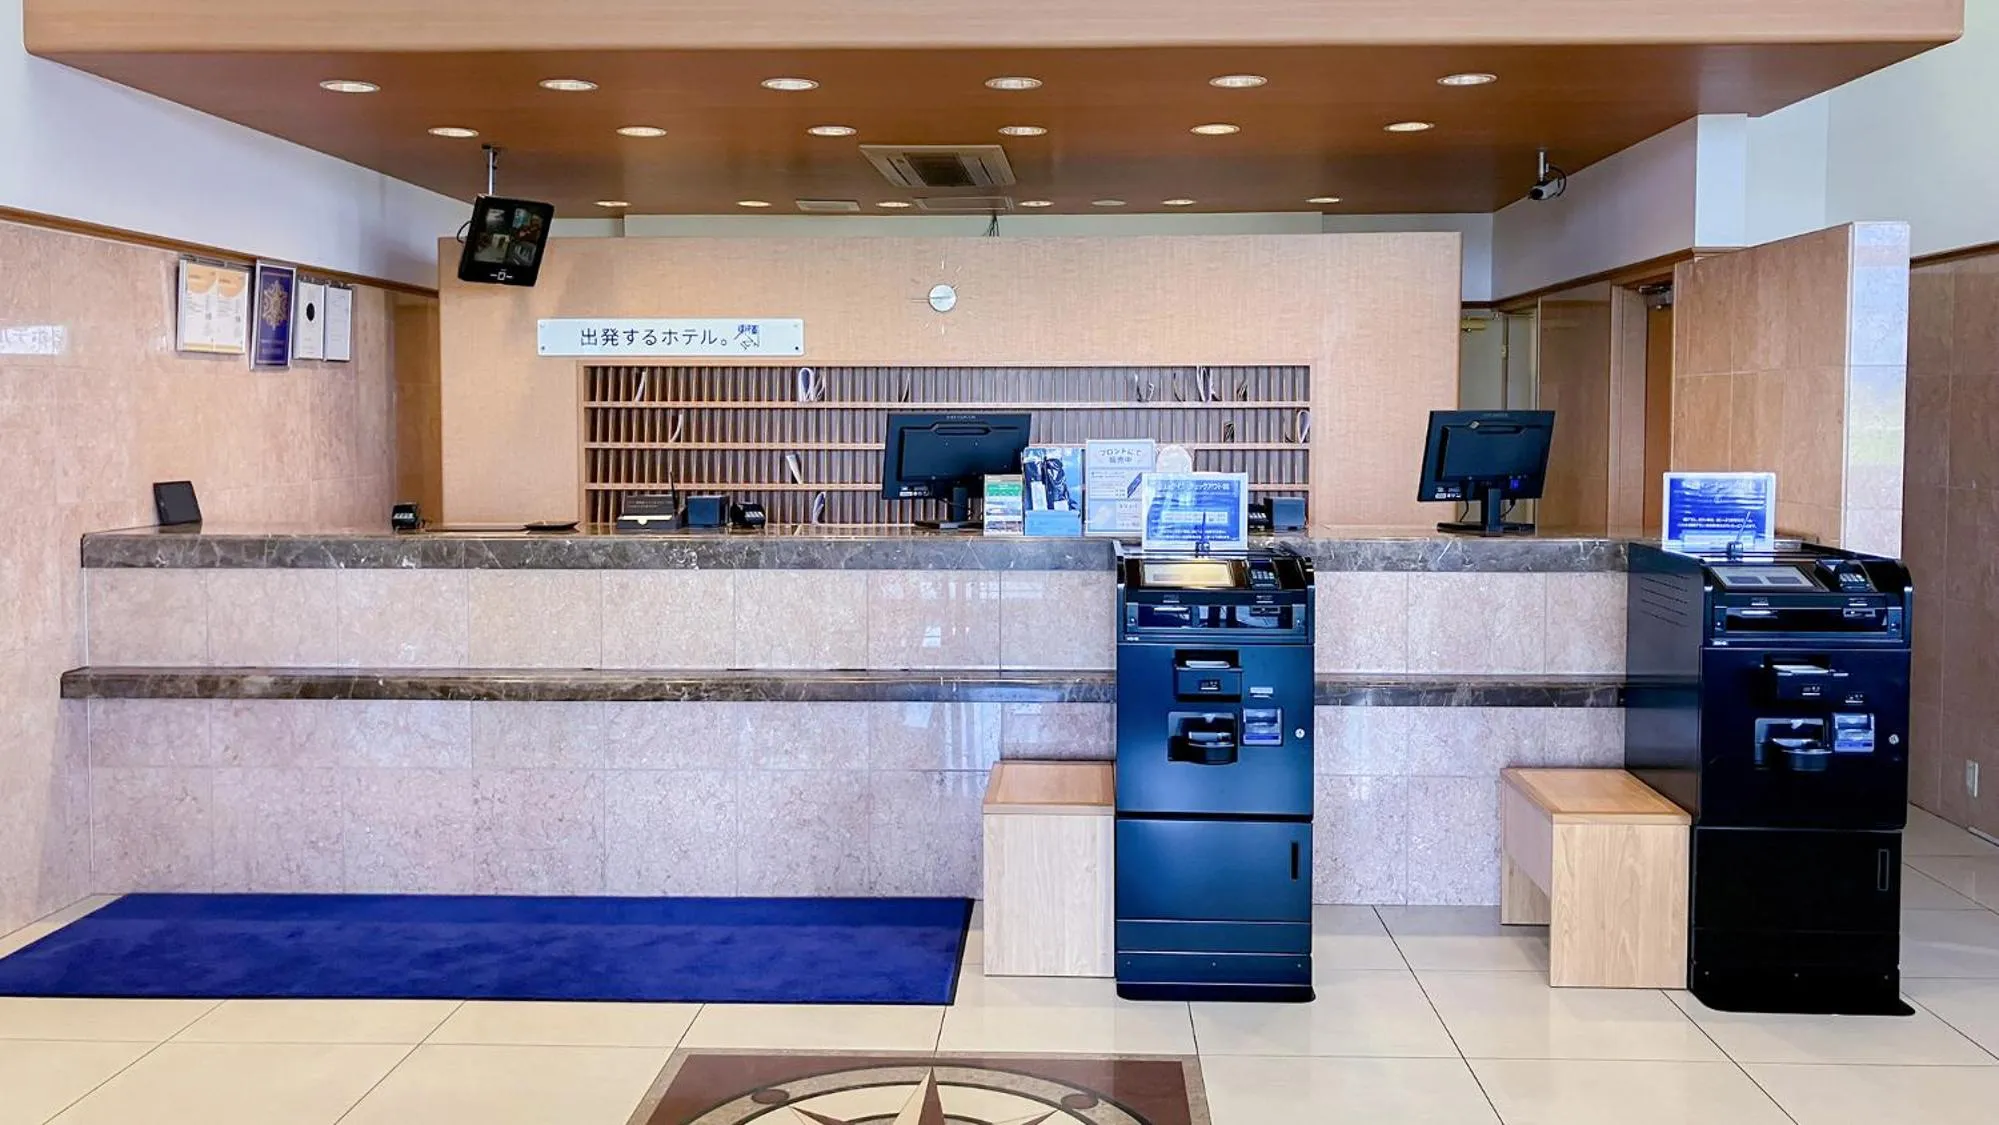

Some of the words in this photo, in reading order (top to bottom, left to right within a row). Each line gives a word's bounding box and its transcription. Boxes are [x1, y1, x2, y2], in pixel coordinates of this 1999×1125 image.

[580, 328, 729, 347] 出発するホテル。
